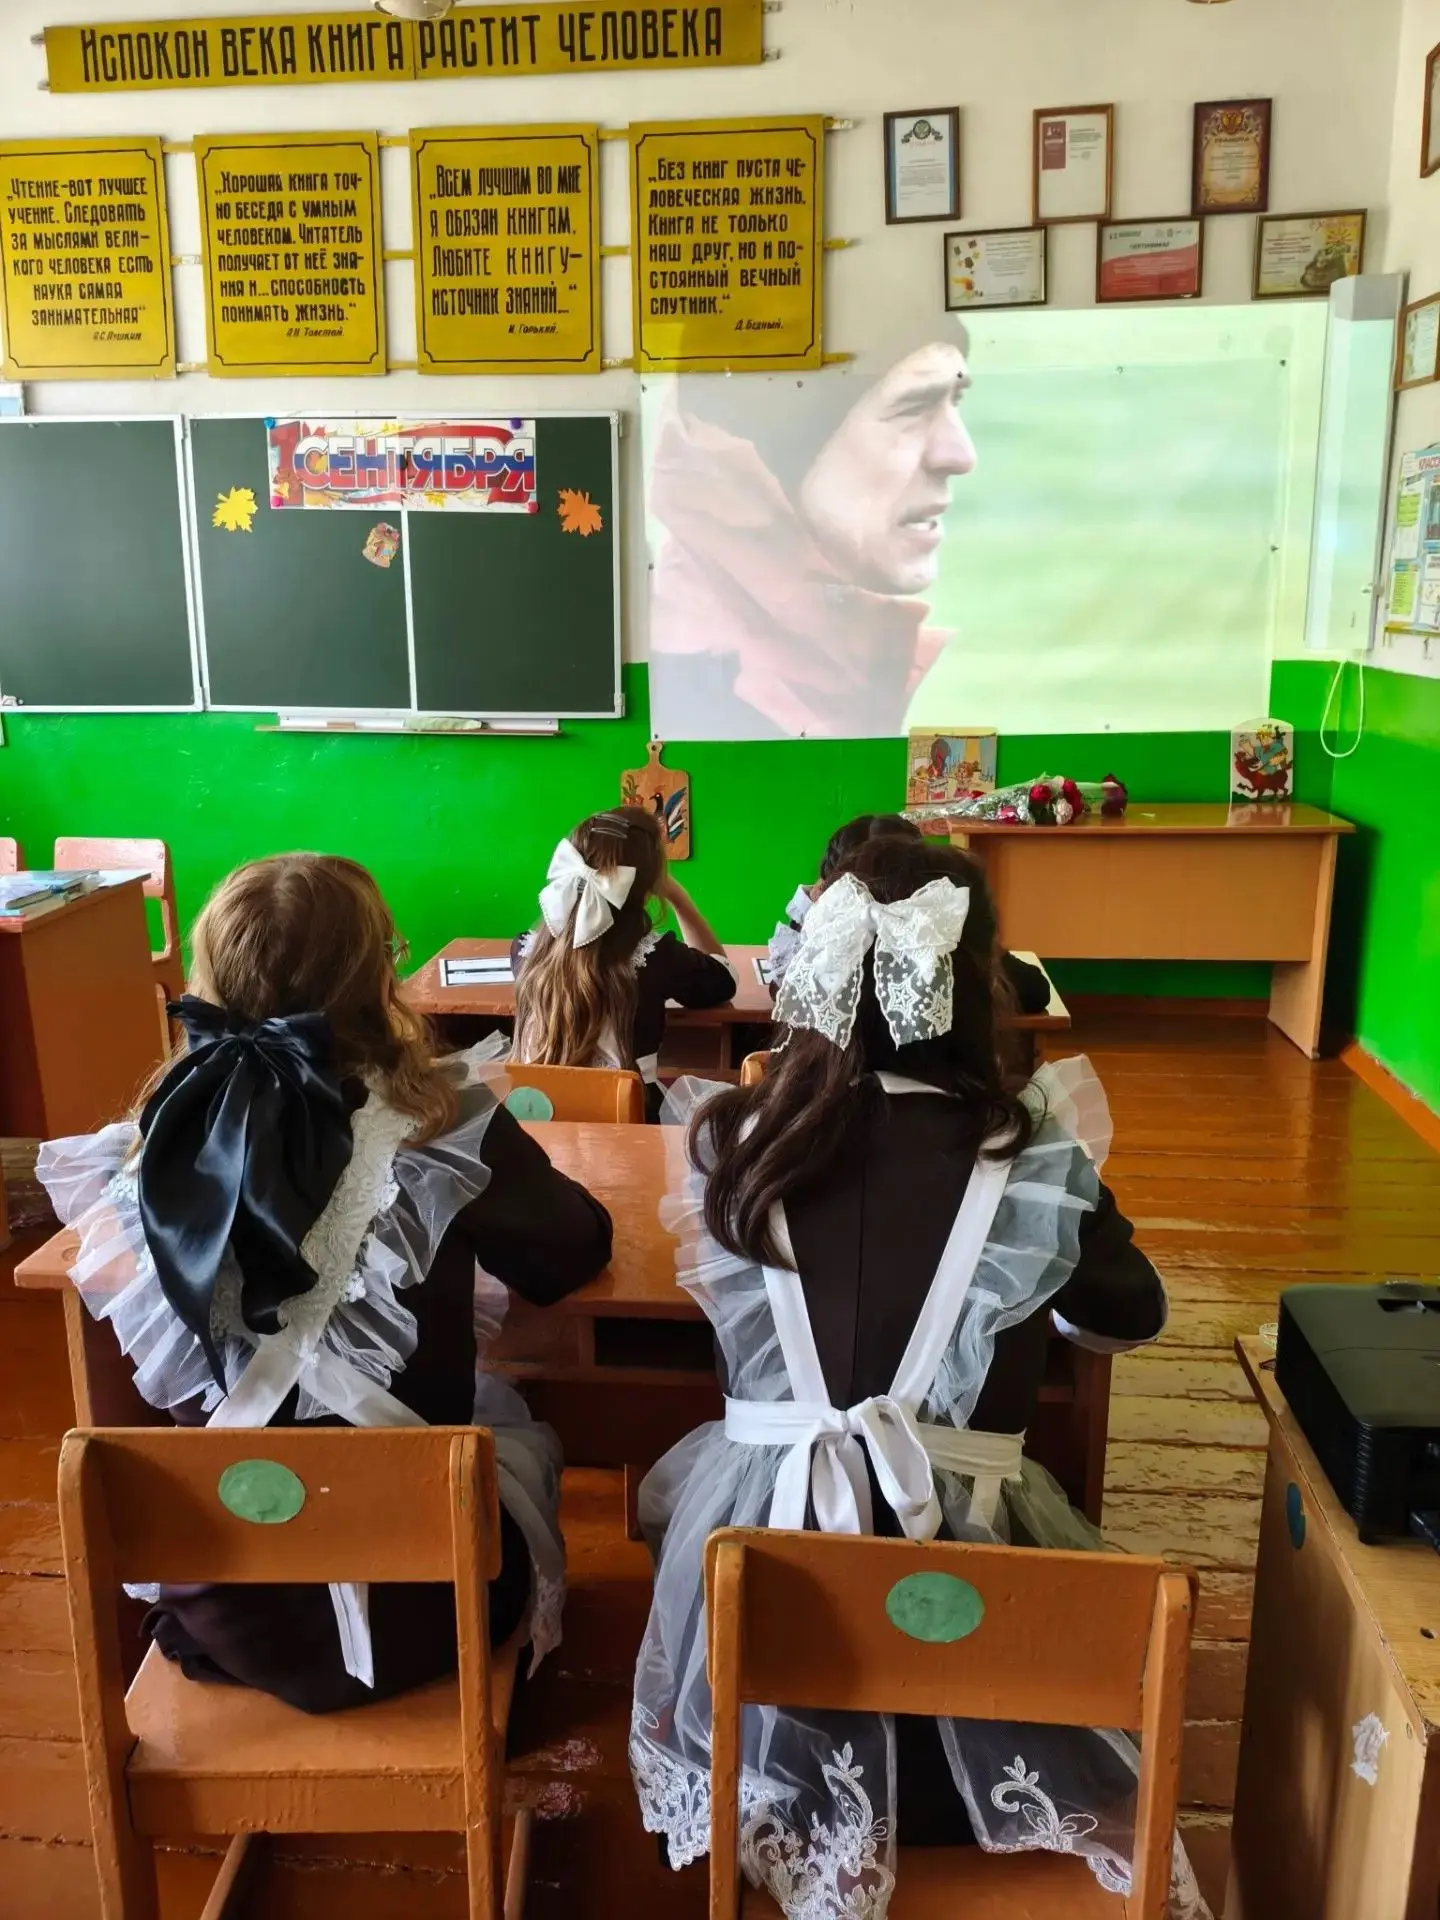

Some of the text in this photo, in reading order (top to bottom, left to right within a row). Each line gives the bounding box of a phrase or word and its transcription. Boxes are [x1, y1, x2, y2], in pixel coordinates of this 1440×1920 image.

[80, 7, 722, 83] ИСПОКОН ВЕКА КНИГА РАСТИТ ЧЕЛОВЕКА
[478, 166, 531, 196] ЛУЧШИМ
[537, 165, 552, 194] ВО
[557, 164, 582, 193] МНЕ
[692, 160, 728, 180] КНИГ
[736, 159, 780, 179] ПУСТА
[99, 177, 148, 196] ЛУЧШЕЕ
[289, 173, 328, 191] КНИГА
[649, 187, 740, 208] ЛОВЕЧЕСКАЯ
[216, 200, 357, 222] НО БЕСЕДА С УМНЫМ
[430, 210, 438, 237] Я
[446, 208, 498, 236] ОБЯЗАН
[648, 214, 788, 236] КНИГА НЕ ТОЛЬКО
[11, 233, 27, 250] ЗА
[34, 233, 99, 249] МЫСЛЯМИ
[298, 223, 363, 245] ЧИТАТЕЛЬ
[218, 253, 278, 272] ПОЛУЧАЕТ
[284, 254, 299, 270] ОТ
[305, 248, 327, 269] НЕЁ
[432, 245, 491, 277] ЛЮБИТЕ
[649, 244, 681, 262] НАШ
[738, 242, 756, 260] НО
[763, 241, 772, 259] И
[13, 256, 153, 276] КОГО ЧЕЛОВЕКА ЕСТЬ
[650, 262, 801, 289] СТОЯННЫЙ ВЕЧНЫЙ
[34, 282, 122, 300] НАУКА САМАЯ
[220, 280, 244, 297] НИЯ
[432, 287, 499, 316] ИСТОЧНИК
[222, 304, 289, 323] ПОНИМАТЬ
[293, 436, 537, 493] СЕНТЯБРЯ
